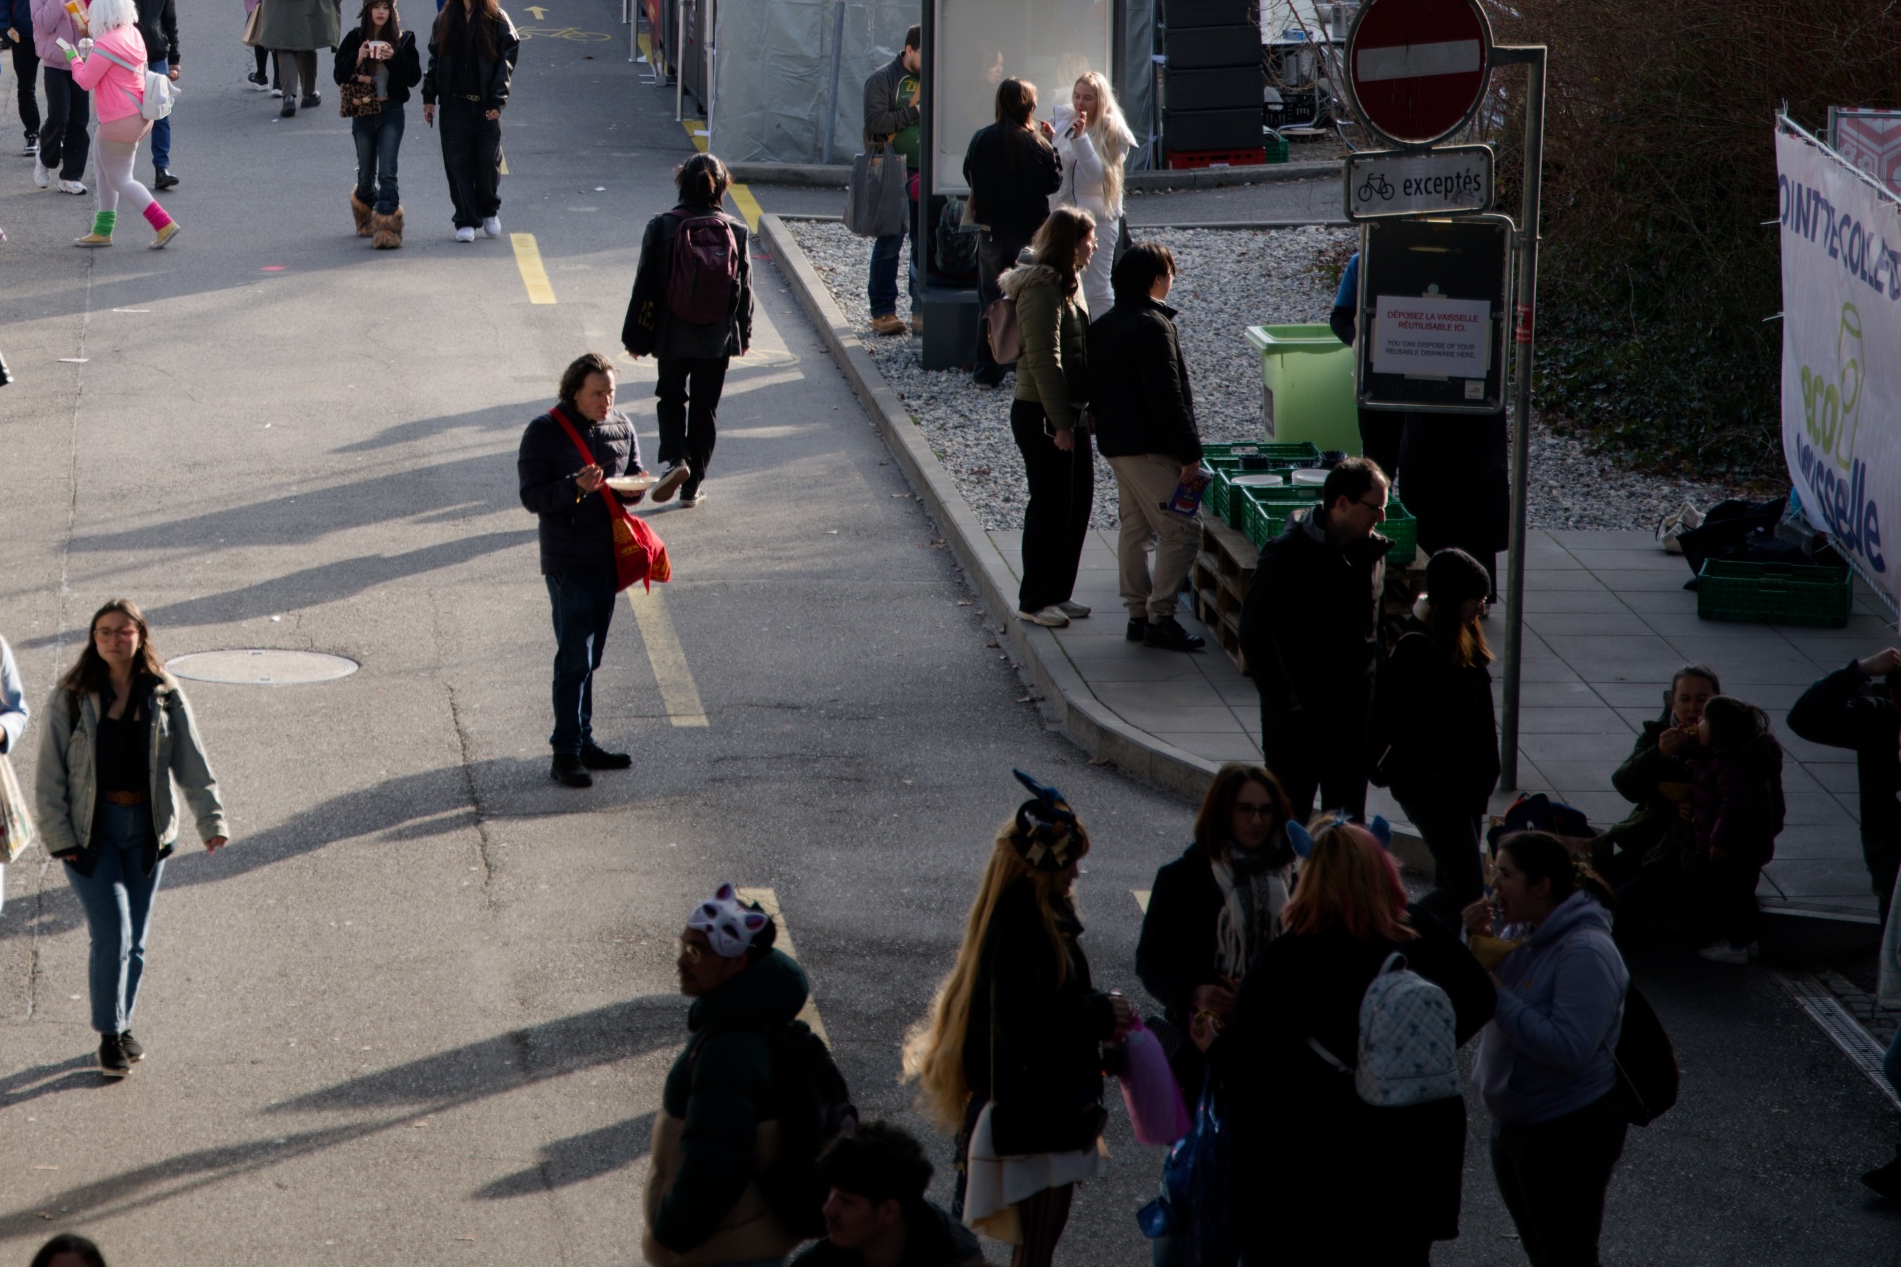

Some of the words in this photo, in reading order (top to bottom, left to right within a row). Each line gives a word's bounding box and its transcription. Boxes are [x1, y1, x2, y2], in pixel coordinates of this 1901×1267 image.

[1403, 167, 1481, 201] exceptés
[1387, 310, 1424, 319] DÉPOSEZ
[1426, 312, 1436, 320] LA
[1437, 313, 1479, 323] VAISSELLE
[1398, 320, 1452, 331] RÉUTILISABLE
[1454, 324, 1467, 332] ICI.
[1417, 341, 1445, 349] DISPOSE
[1386, 347, 1419, 356] REUSABLE
[1420, 349, 1455, 357] DISHWARE
[1456, 351, 1476, 359] HERE.
[1801, 364, 1839, 456] eco
